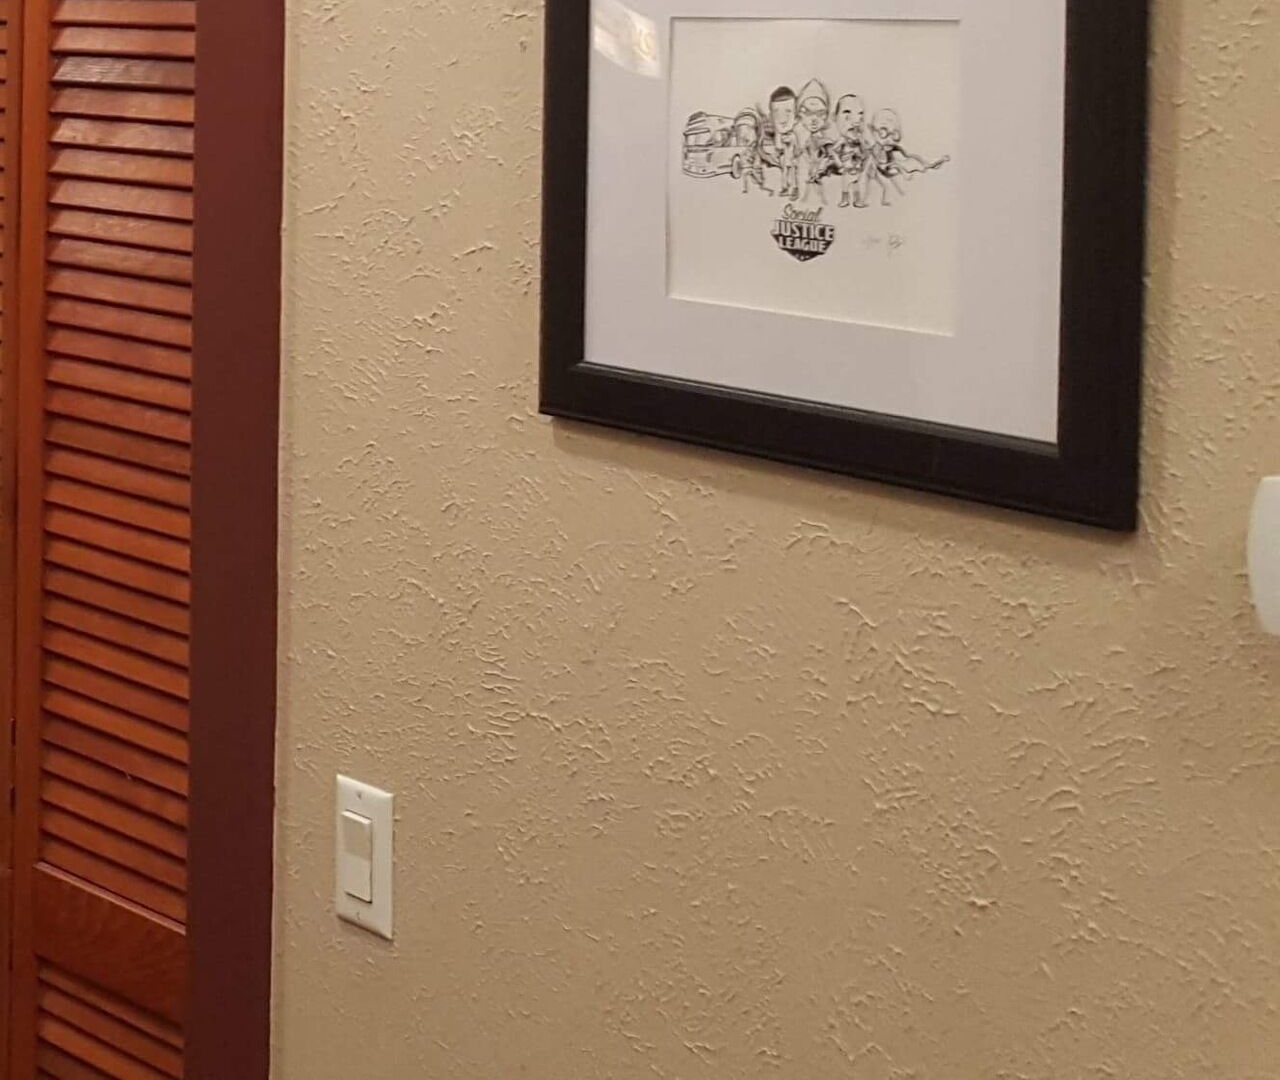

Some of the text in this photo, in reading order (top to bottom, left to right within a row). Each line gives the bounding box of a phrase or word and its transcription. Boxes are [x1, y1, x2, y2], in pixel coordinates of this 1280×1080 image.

[781, 202, 824, 222] Social
[770, 220, 835, 241] JUSTICE
[778, 236, 829, 253] LEAGUE
